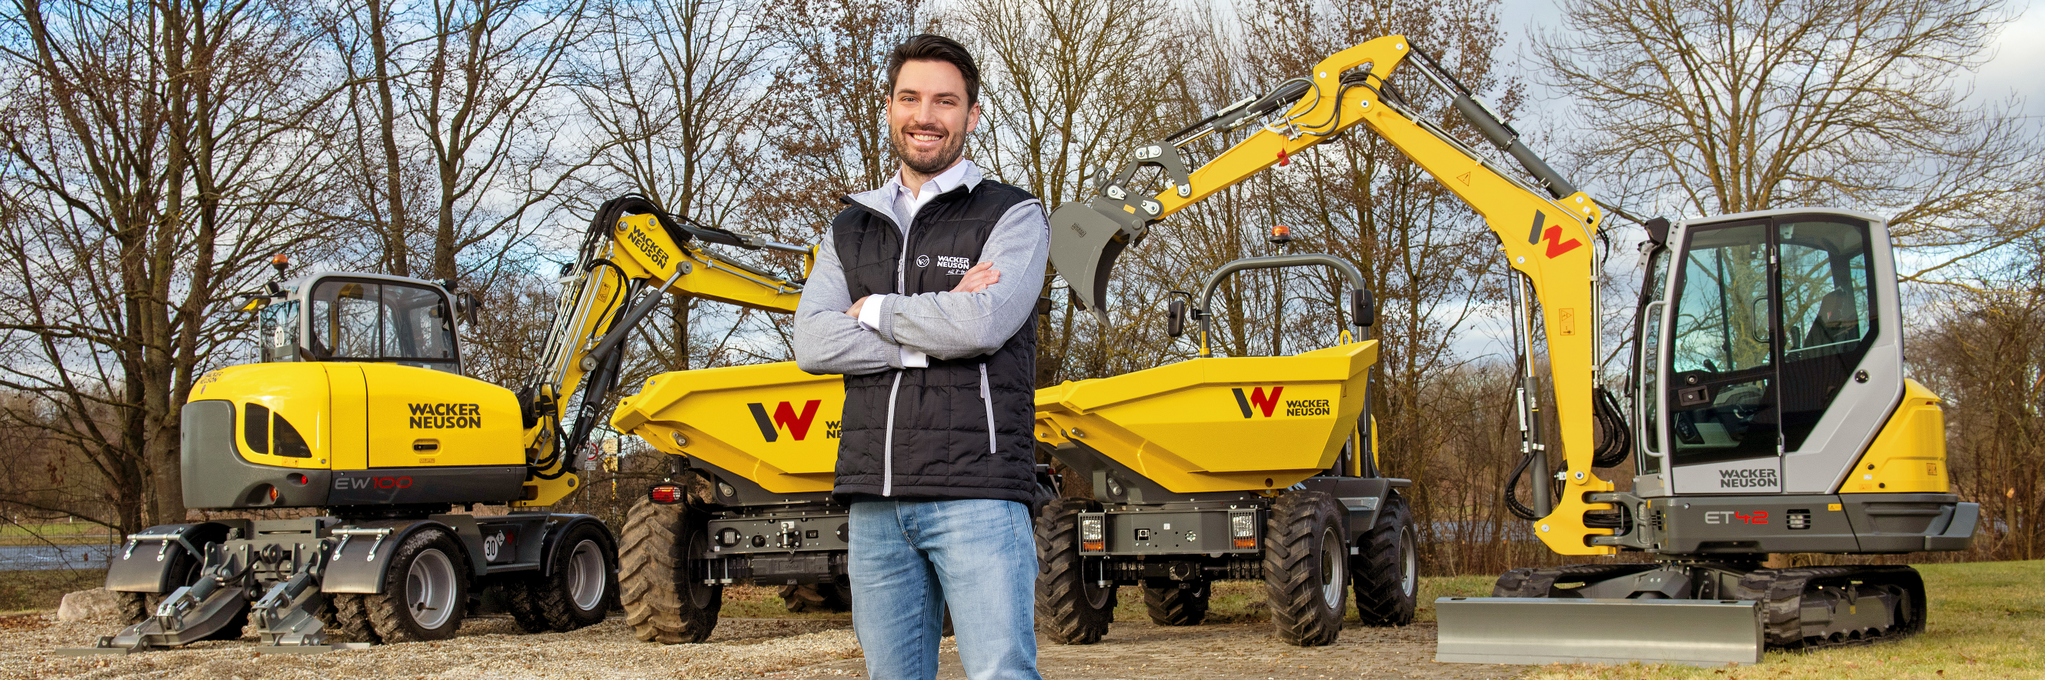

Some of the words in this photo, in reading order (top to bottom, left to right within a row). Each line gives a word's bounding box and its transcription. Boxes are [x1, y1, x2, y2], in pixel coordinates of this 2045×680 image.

[628, 232, 666, 269] NEUSON
[633, 225, 669, 263] WACKER
[936, 261, 970, 269] NEUSON
[937, 255, 969, 264] WACKER
[408, 403, 481, 416] WACKER
[1286, 399, 1330, 408] WACKER
[1286, 408, 1330, 416] NEUSON
[409, 416, 481, 429] NEUSON
[1718, 469, 1777, 479] WACKER
[334, 476, 413, 490] EW100
[1720, 478, 1778, 488] NEUSON
[1704, 511, 1769, 524] ET42
[486, 540, 496, 557] 30
